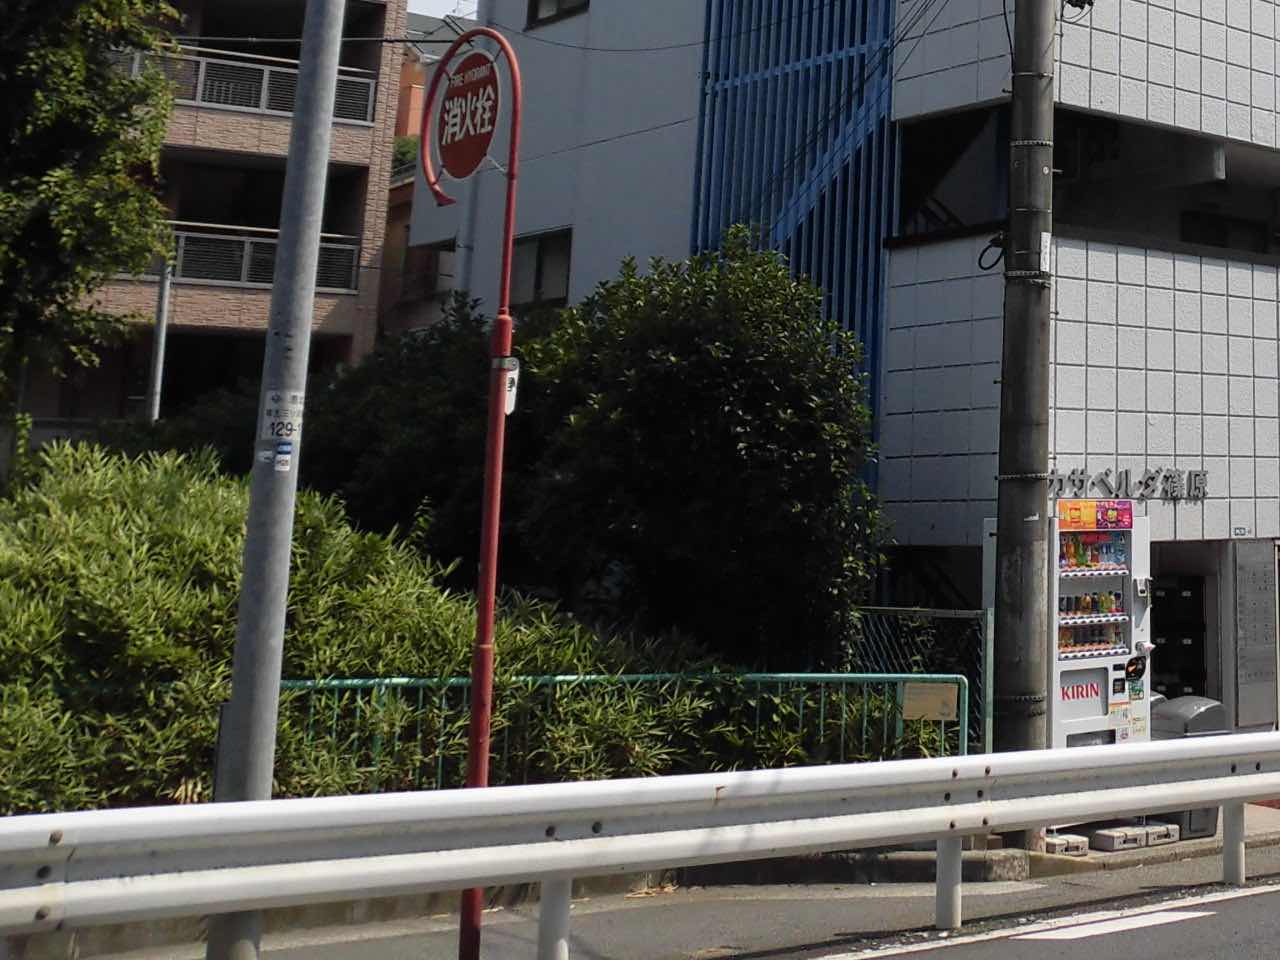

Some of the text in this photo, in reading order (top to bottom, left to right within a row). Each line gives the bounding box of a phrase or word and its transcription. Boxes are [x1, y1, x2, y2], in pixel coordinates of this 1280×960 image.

[441, 85, 495, 145] 消火栓
[1061, 682, 1099, 700] KIRIN
